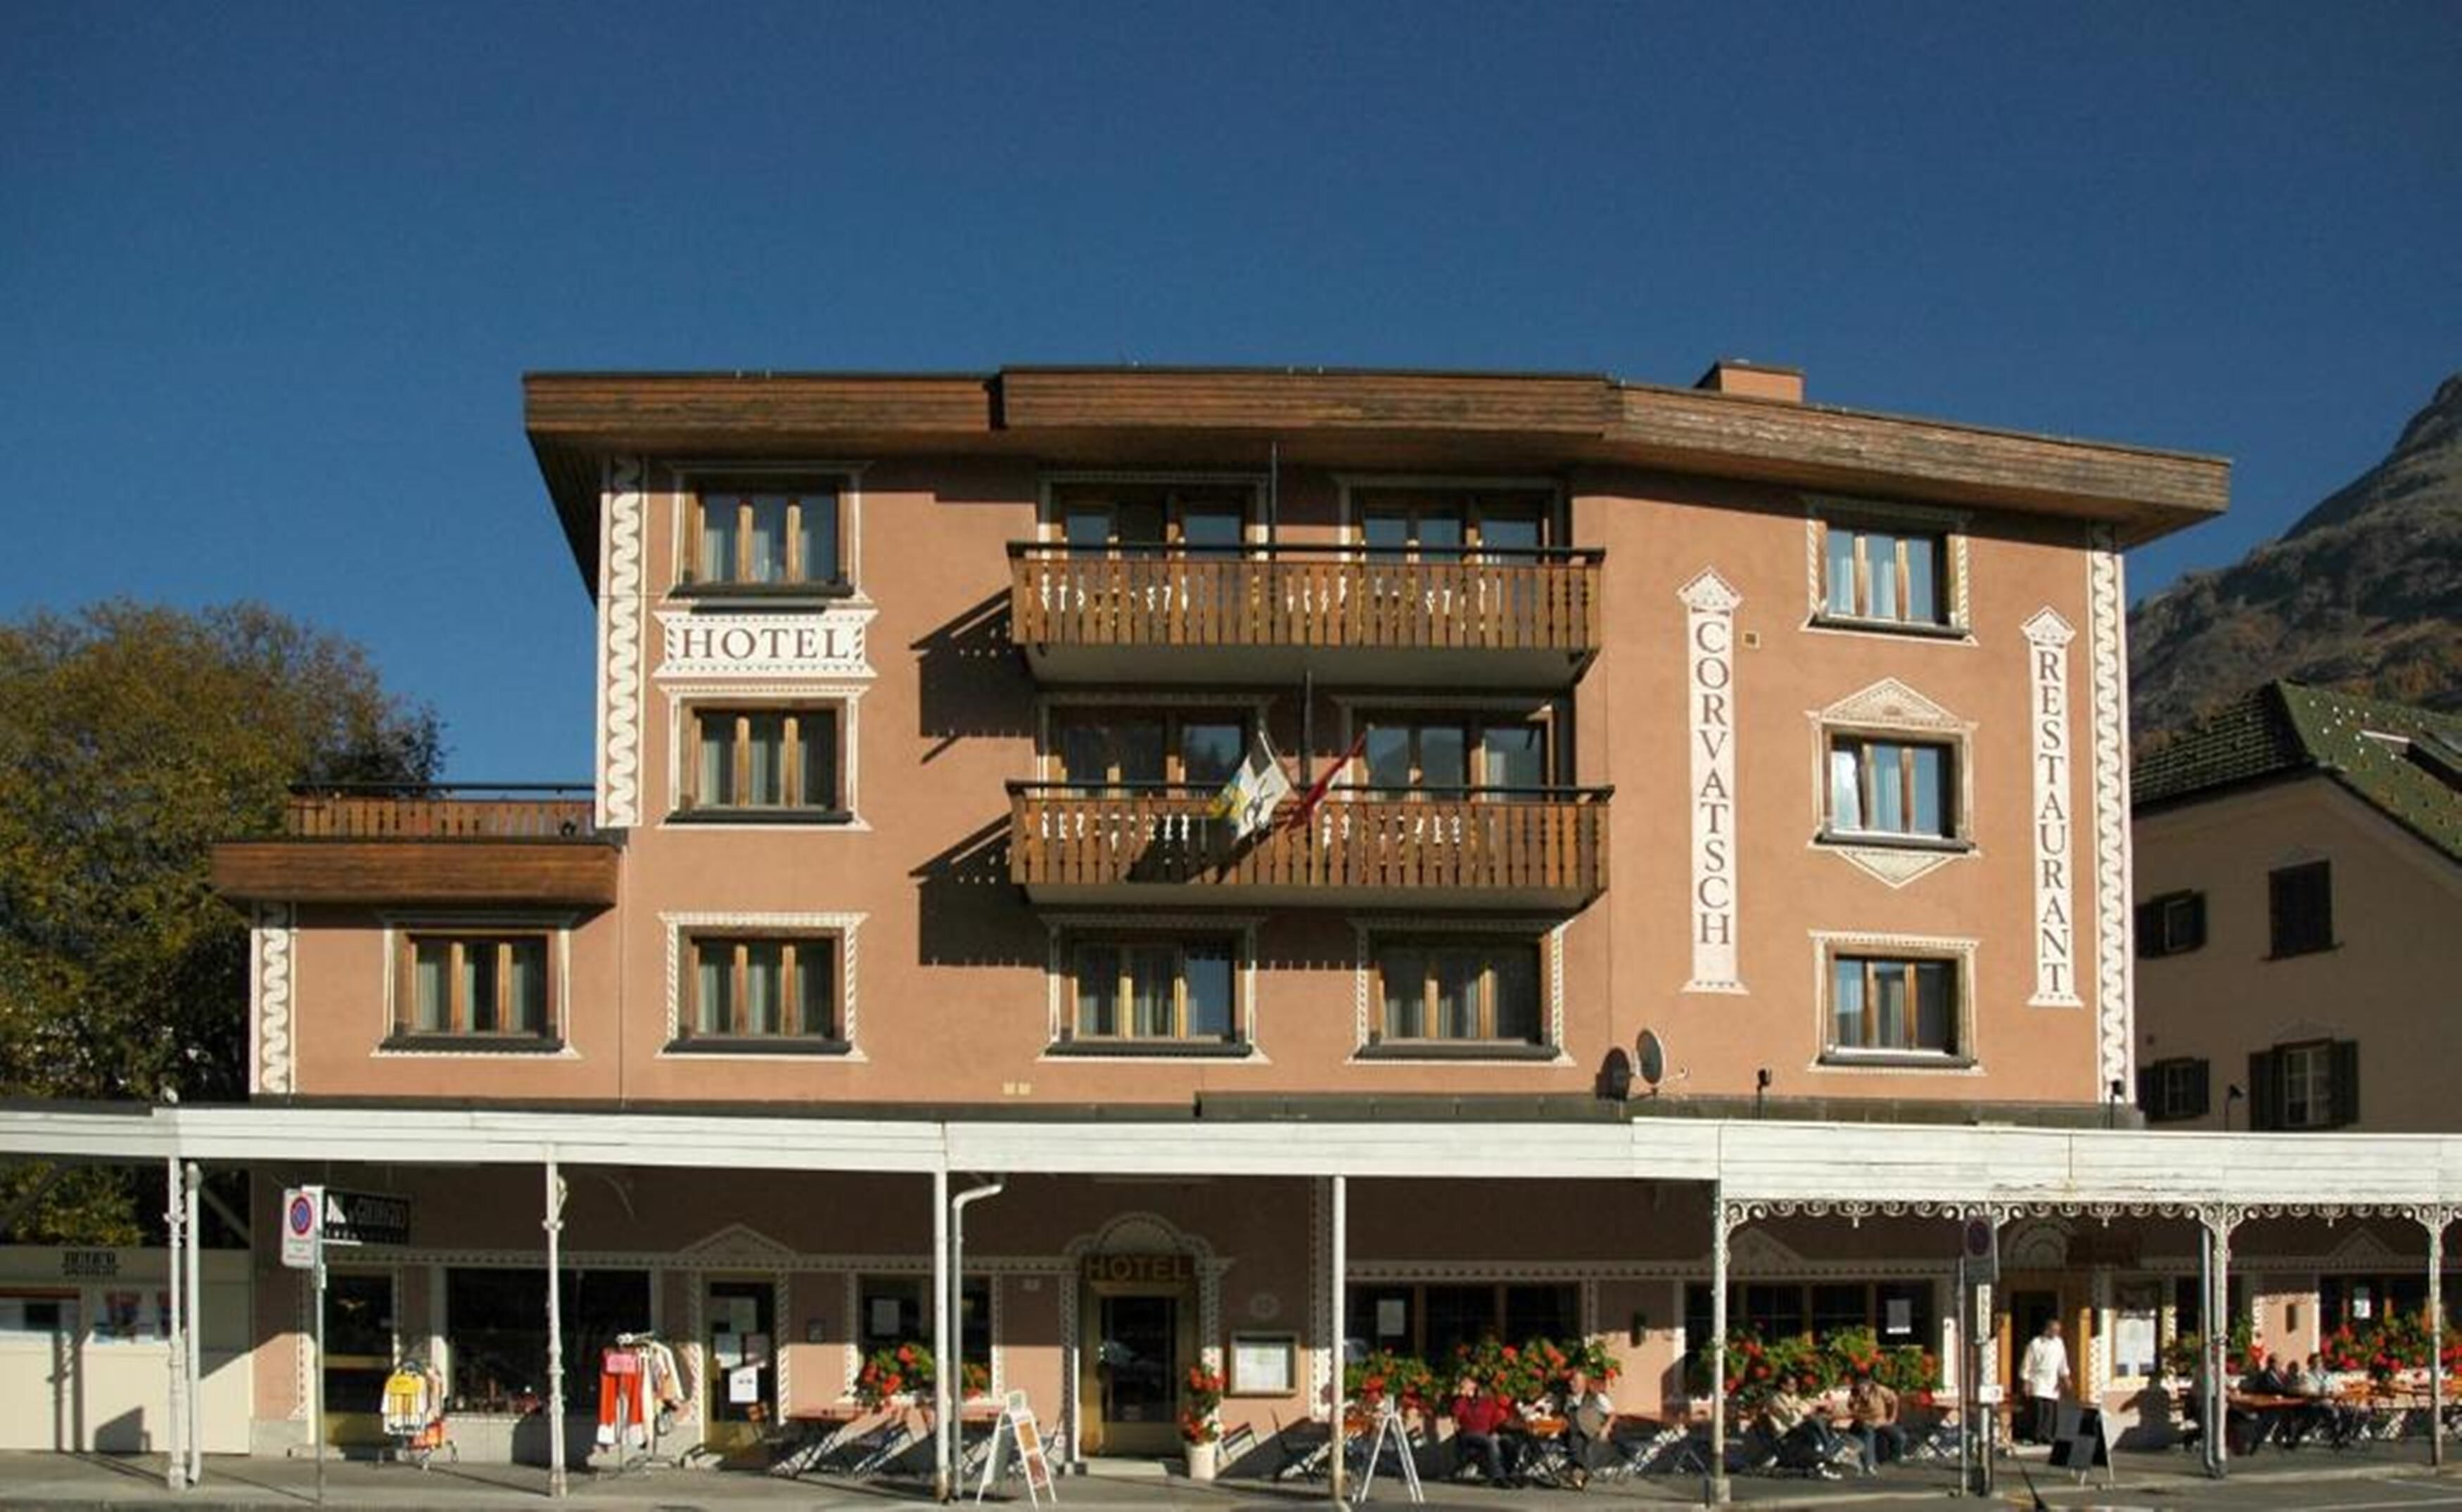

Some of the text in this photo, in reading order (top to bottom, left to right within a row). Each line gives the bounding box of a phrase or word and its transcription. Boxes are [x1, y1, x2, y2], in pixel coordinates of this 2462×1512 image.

[682, 627, 848, 659] HOTEL
[1696, 621, 1730, 944] CORVATSCH
[2038, 650, 2068, 992] RESTAURANT
[1085, 1256, 1191, 1281] HOTEL
